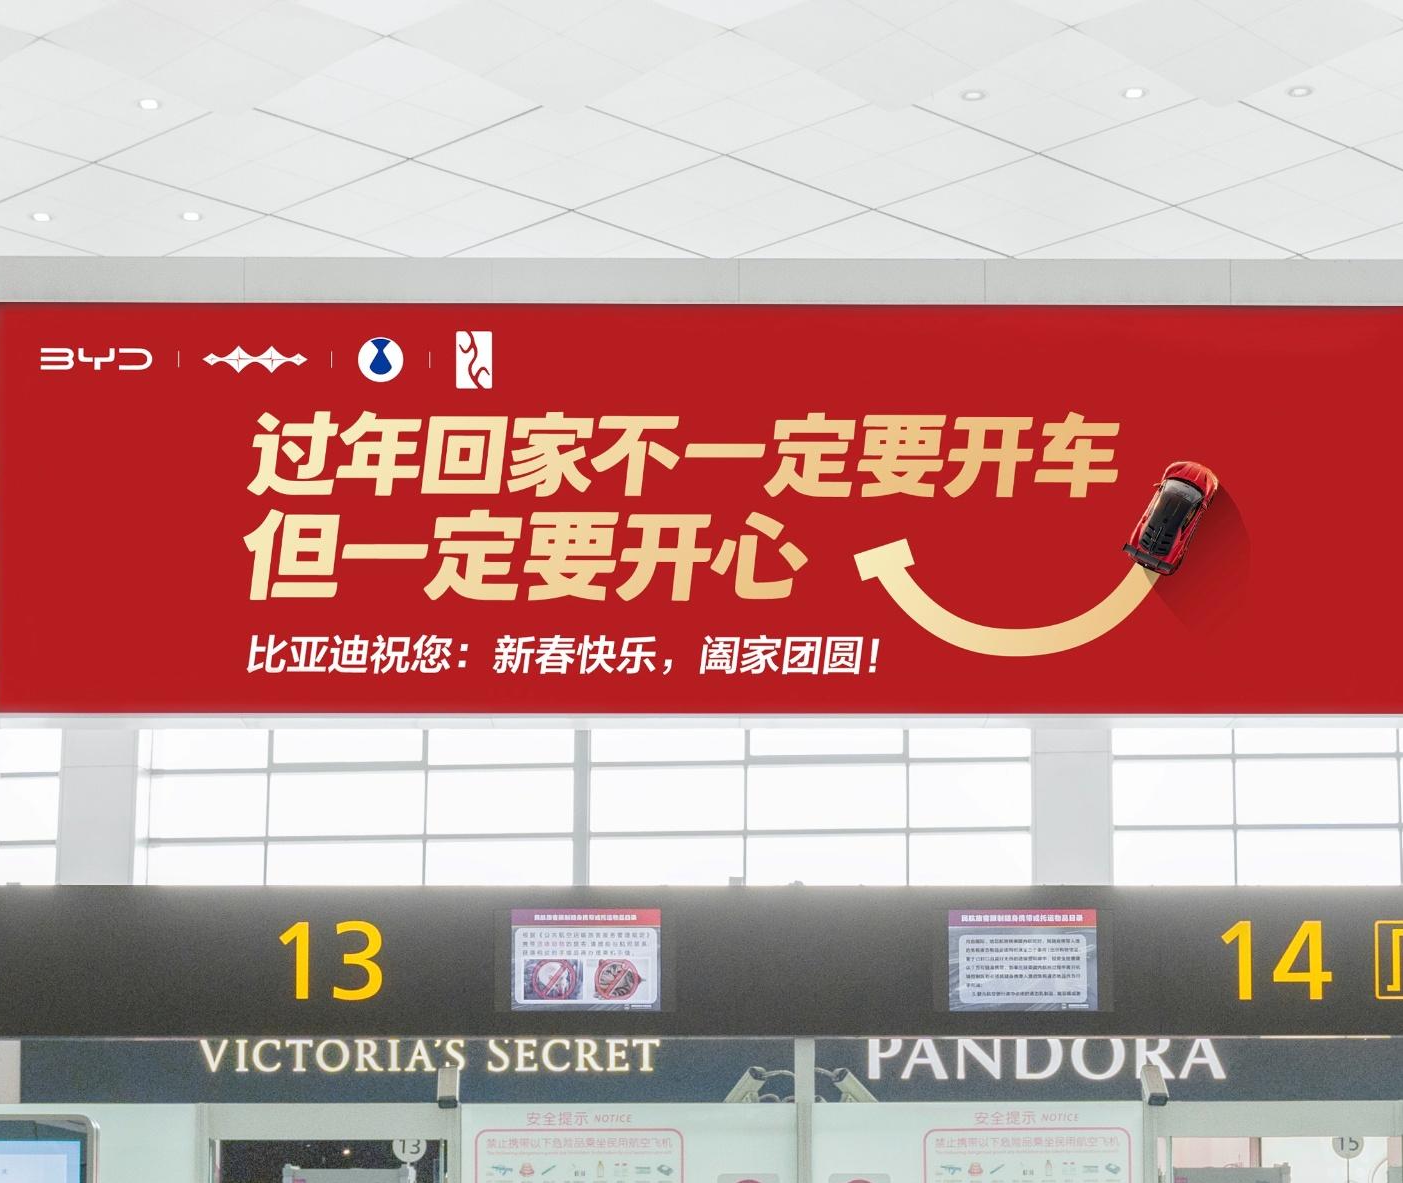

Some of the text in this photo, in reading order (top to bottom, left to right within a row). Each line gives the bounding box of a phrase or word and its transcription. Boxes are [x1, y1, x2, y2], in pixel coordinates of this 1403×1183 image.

[40, 347, 153, 371] BYD
[246, 410, 1120, 498] 过年回家不一定要开车
[242, 508, 809, 602] 但一定要开心
[279, 919, 384, 1002] 13
[1221, 920, 1334, 1001] 14
[487, 1039, 661, 1073] SECRET
[867, 1040, 1227, 1080] PANDORA
[526, 1112, 633, 1126] 安全提示 NOTICE
[974, 1111, 1079, 1125] 安全提示 NOTICE
